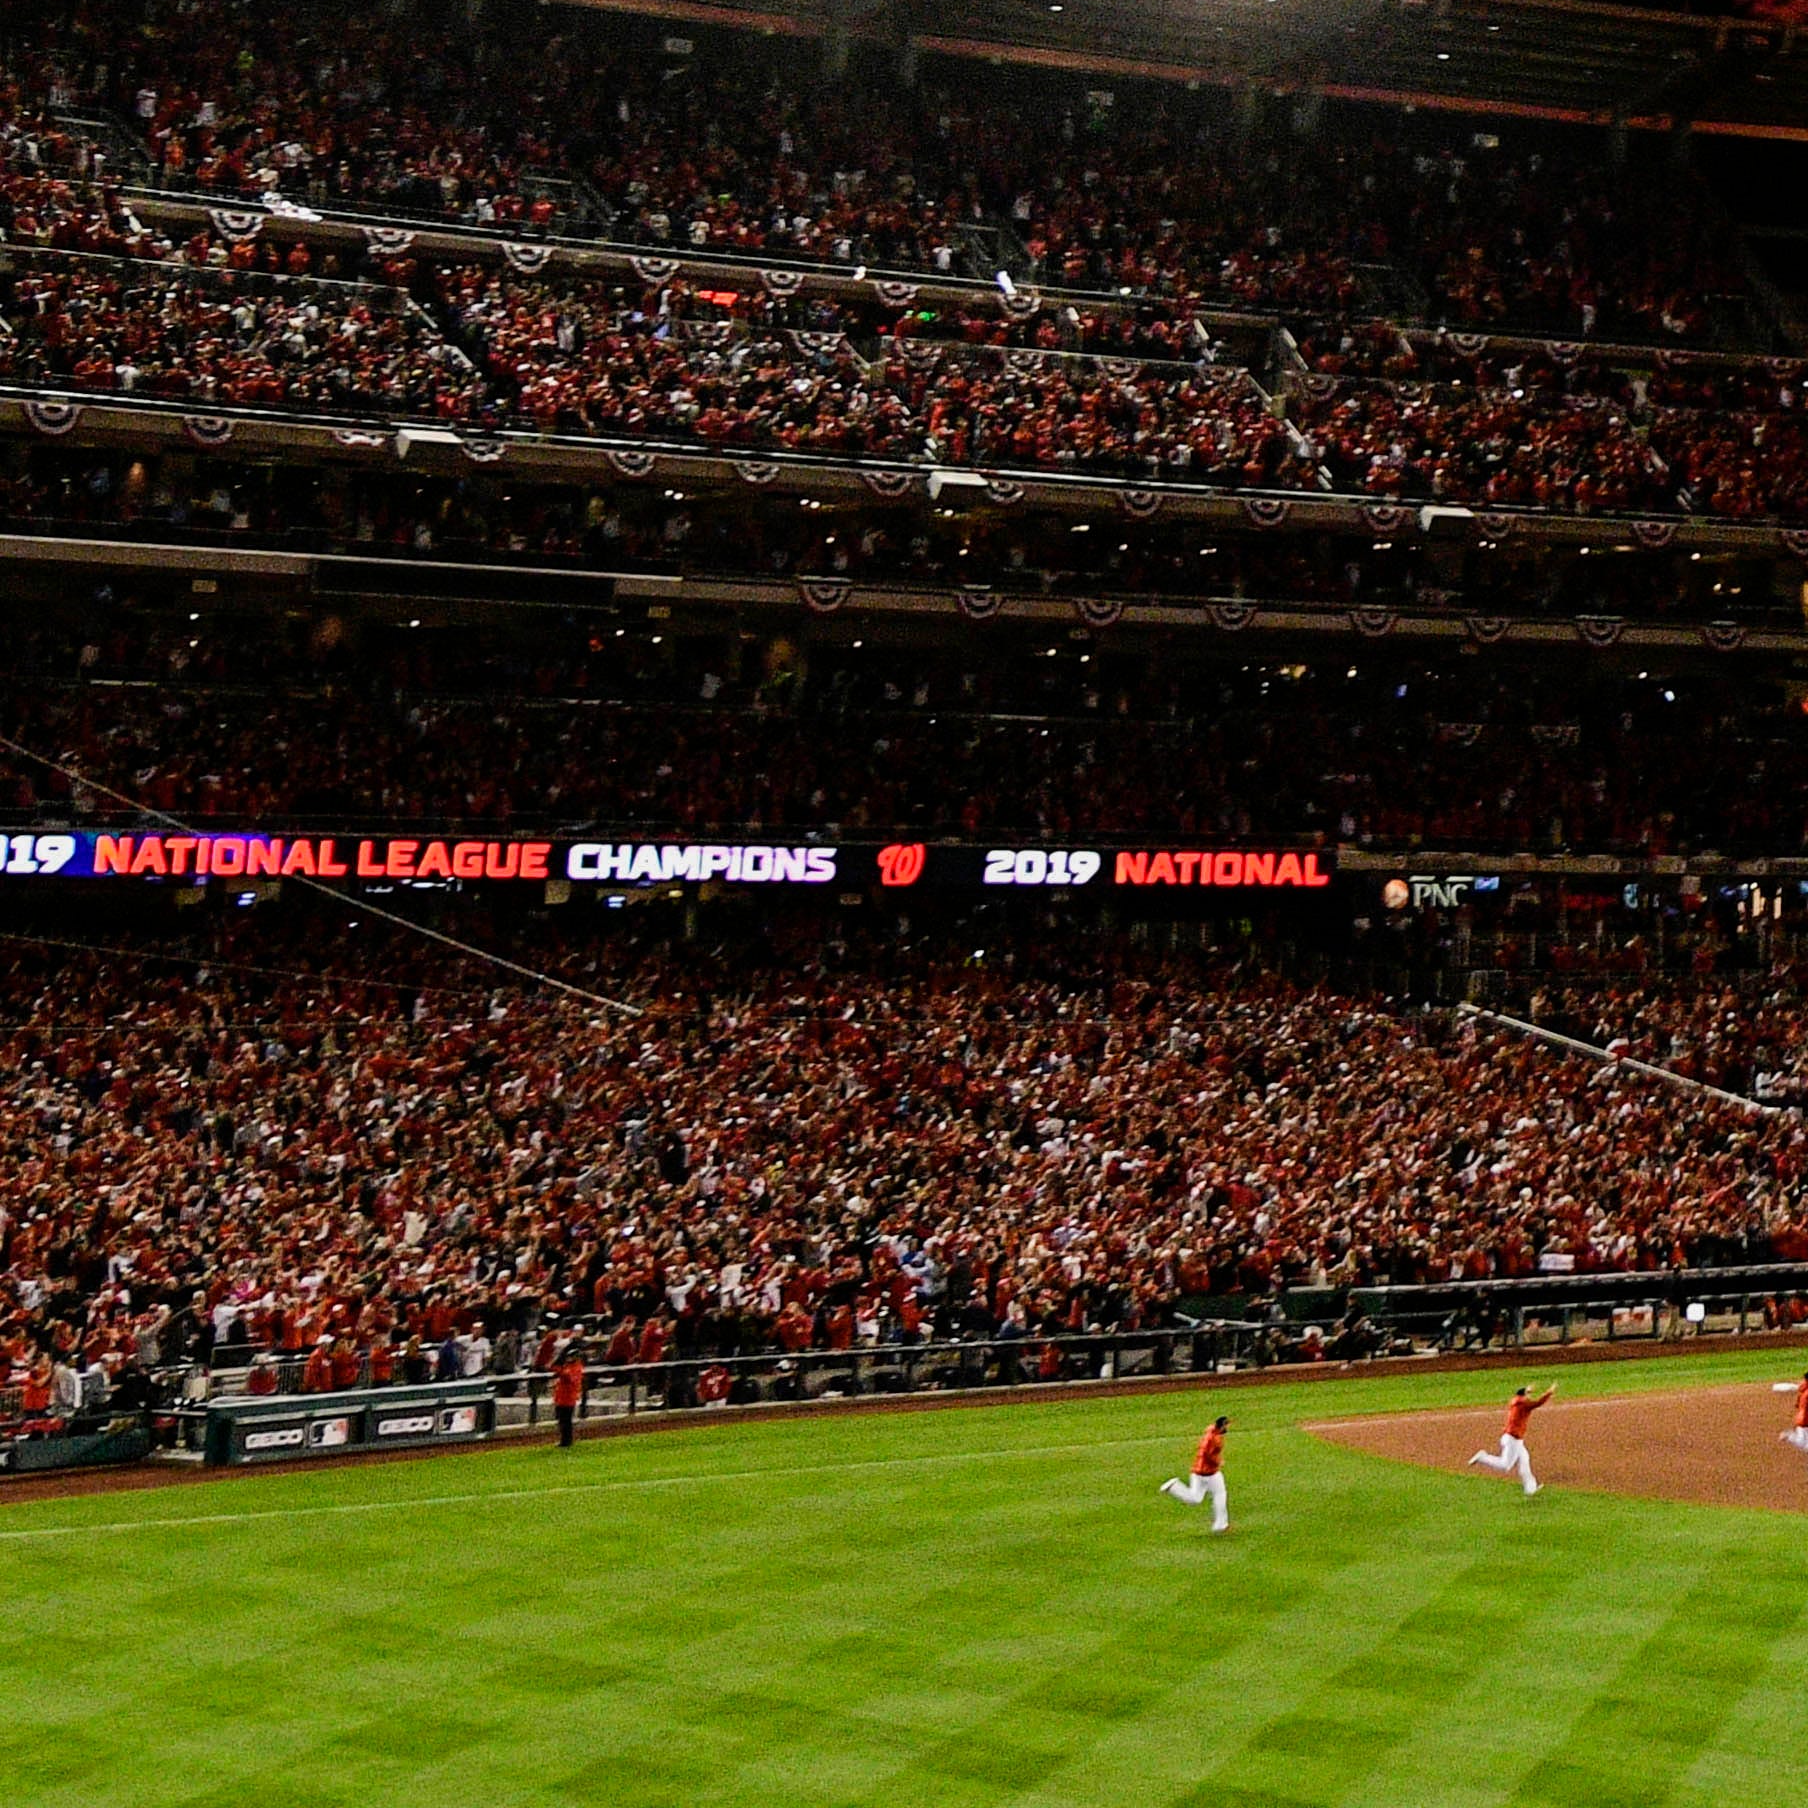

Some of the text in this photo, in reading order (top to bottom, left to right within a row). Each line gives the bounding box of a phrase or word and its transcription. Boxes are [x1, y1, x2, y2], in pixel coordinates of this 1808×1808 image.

[0, 833, 837, 882] 19 NATIONAL LEAGUE CHAMPIONS
[983, 849, 1329, 886] 2019 NATIONAL
[1413, 883, 1469, 908] PNC
